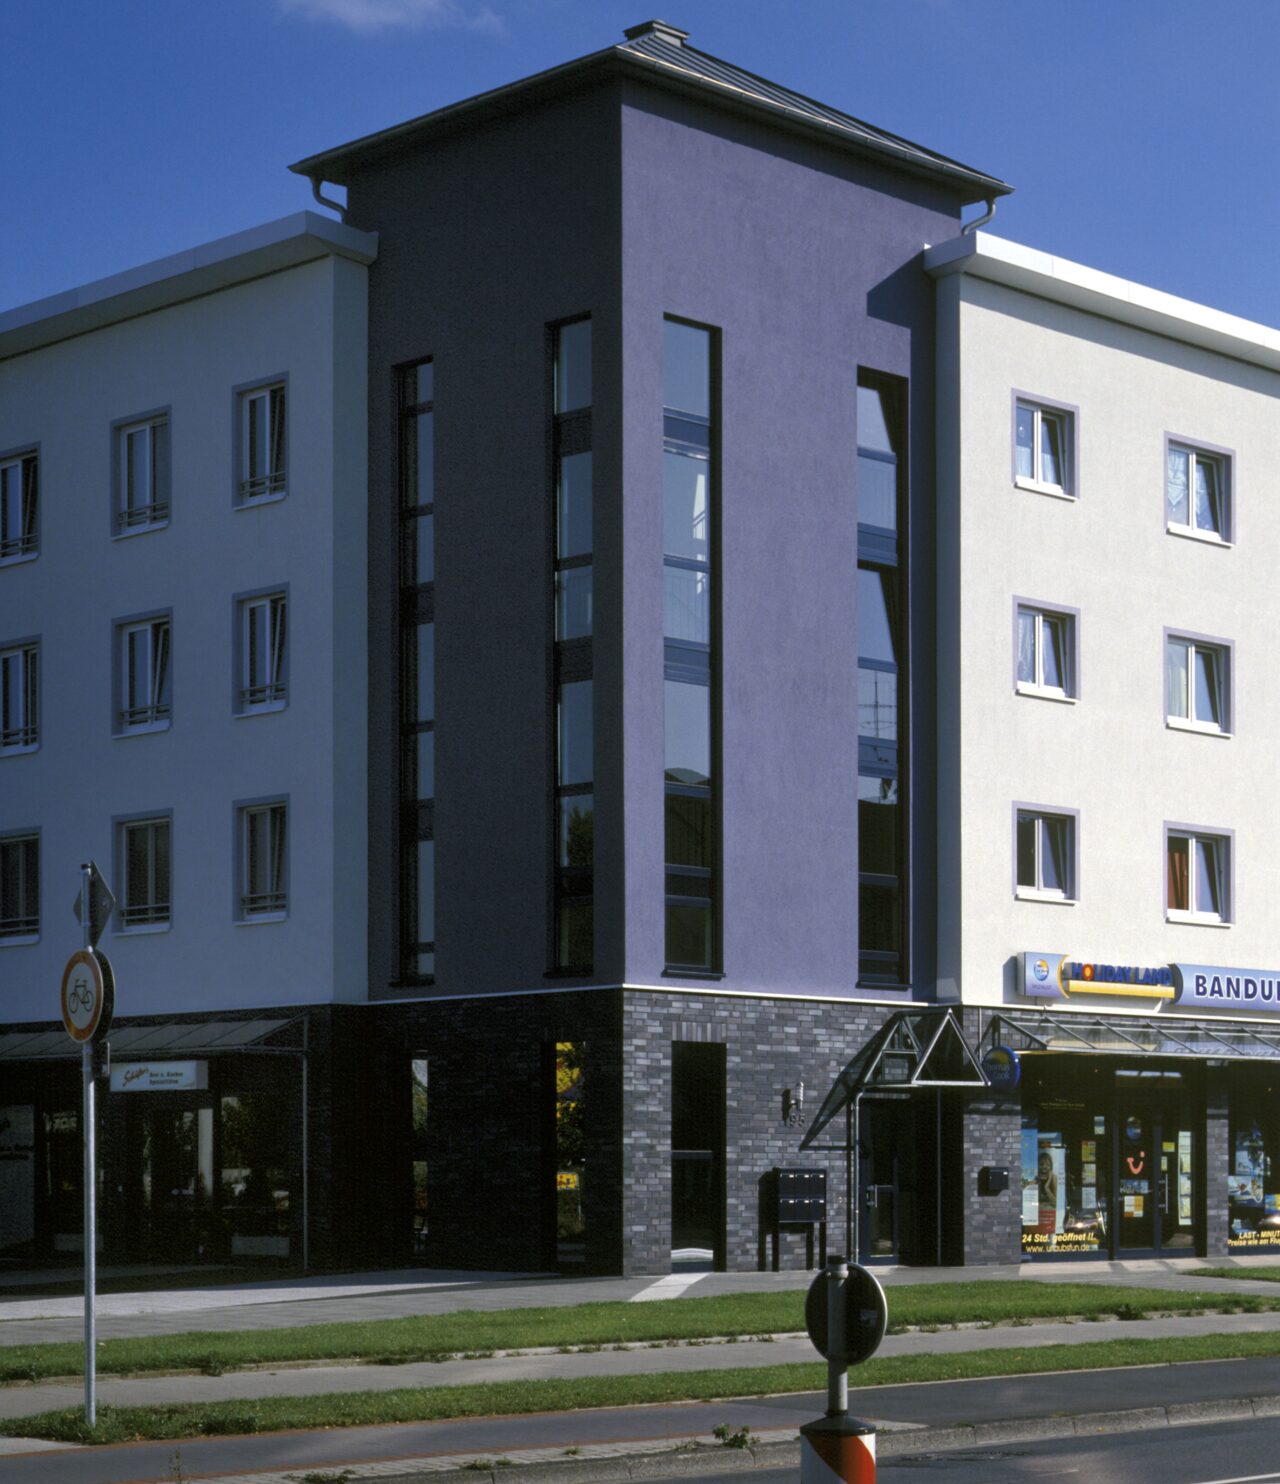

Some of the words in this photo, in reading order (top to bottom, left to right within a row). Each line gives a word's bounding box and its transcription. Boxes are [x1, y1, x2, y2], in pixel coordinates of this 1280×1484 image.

[1071, 961, 1131, 983] HOLIDAY
[1135, 967, 1173, 985] LAND
[1022, 1234, 1032, 1243] 24
[1034, 1233, 1050, 1243] Std.
[1052, 1232, 1086, 1244] geöffnet
[1239, 1230, 1257, 1239] LAST
[1227, 1238, 1247, 1246] Preise
